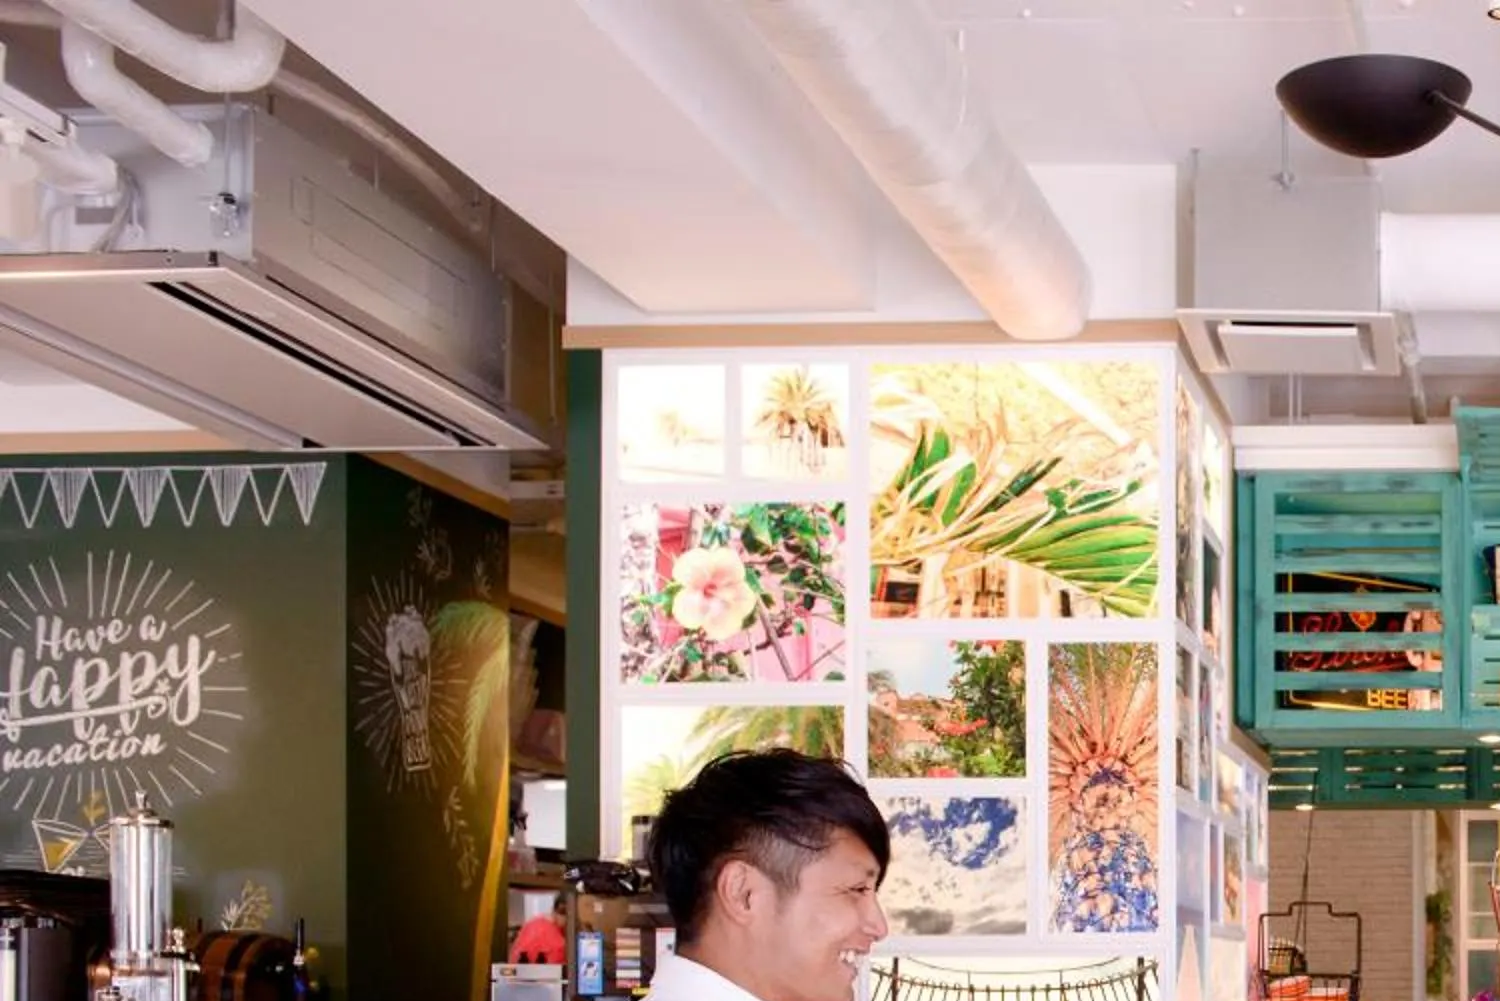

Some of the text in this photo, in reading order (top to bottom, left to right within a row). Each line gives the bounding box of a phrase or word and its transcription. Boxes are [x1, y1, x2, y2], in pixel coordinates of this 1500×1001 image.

[35, 614, 167, 661] Have a
[3, 723, 168, 772] vacation
